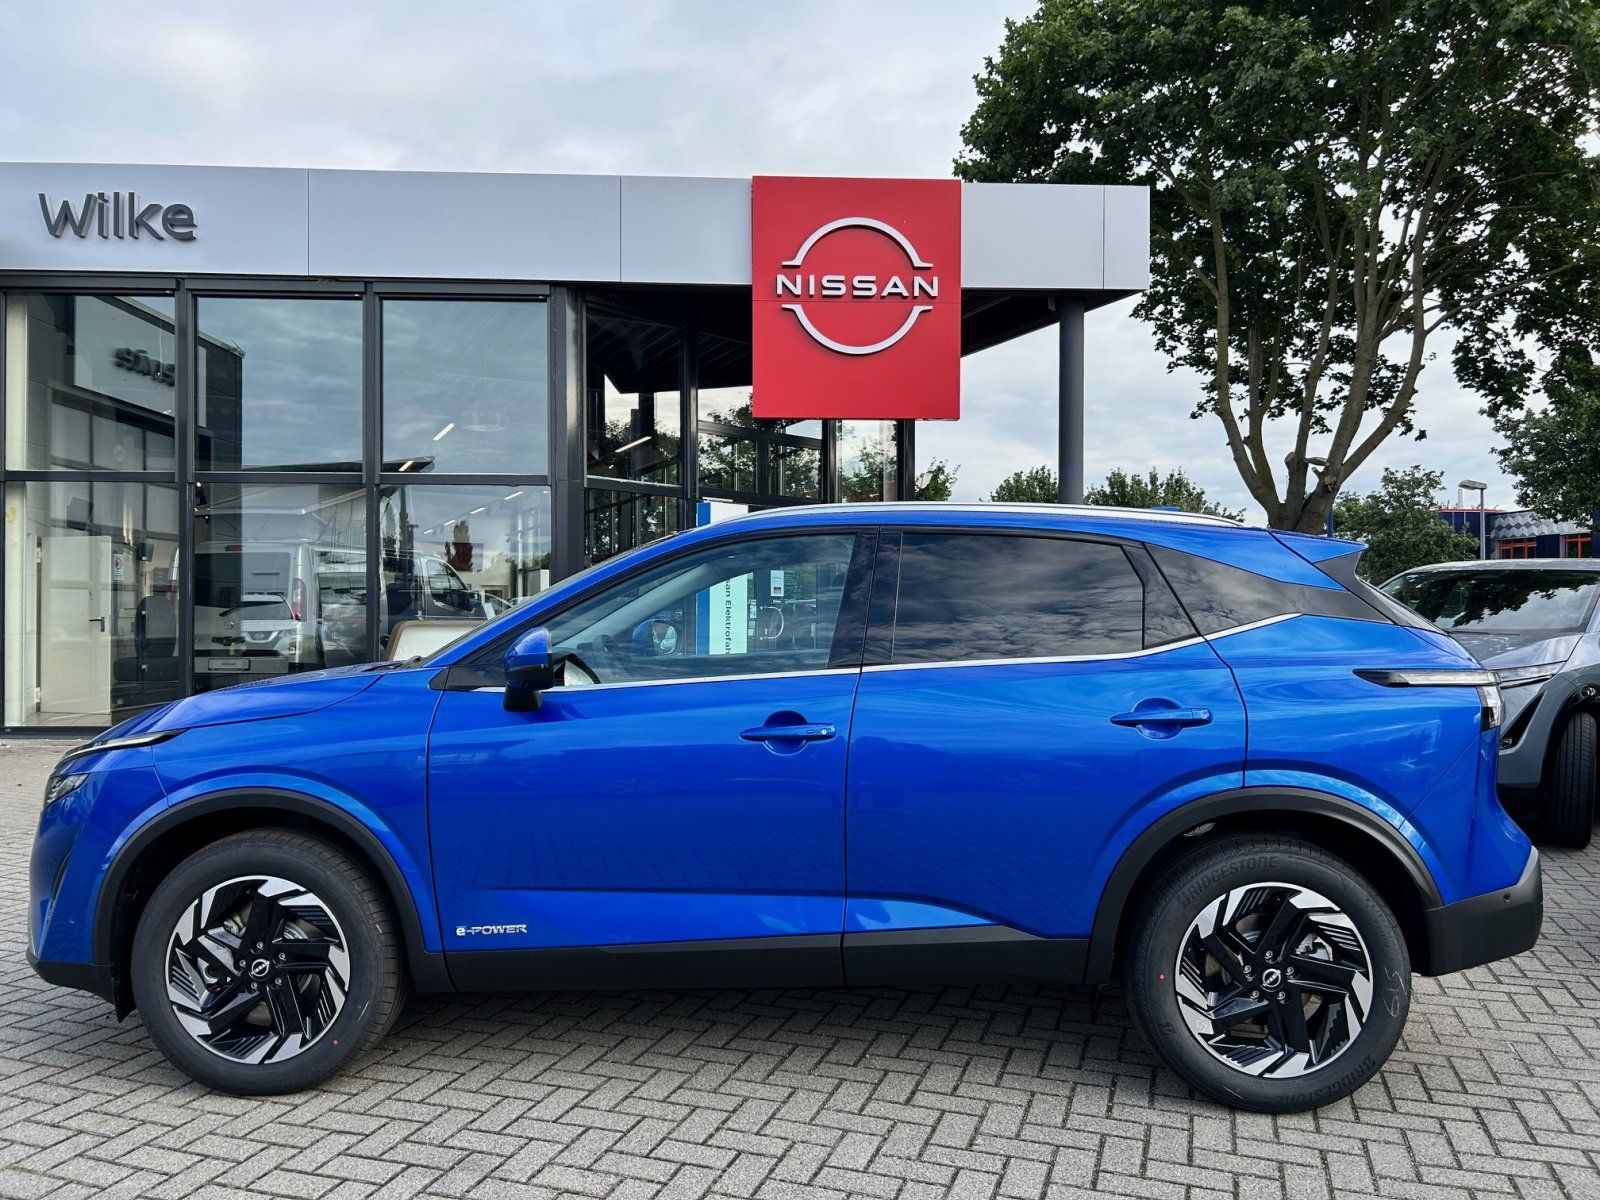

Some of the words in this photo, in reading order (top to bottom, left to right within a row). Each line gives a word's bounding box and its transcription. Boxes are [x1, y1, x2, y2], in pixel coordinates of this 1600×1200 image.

[38, 191, 198, 241] Wilke
[776, 274, 939, 298] NISSAN
[1180, 855, 1279, 907] BRIDGESTONE
